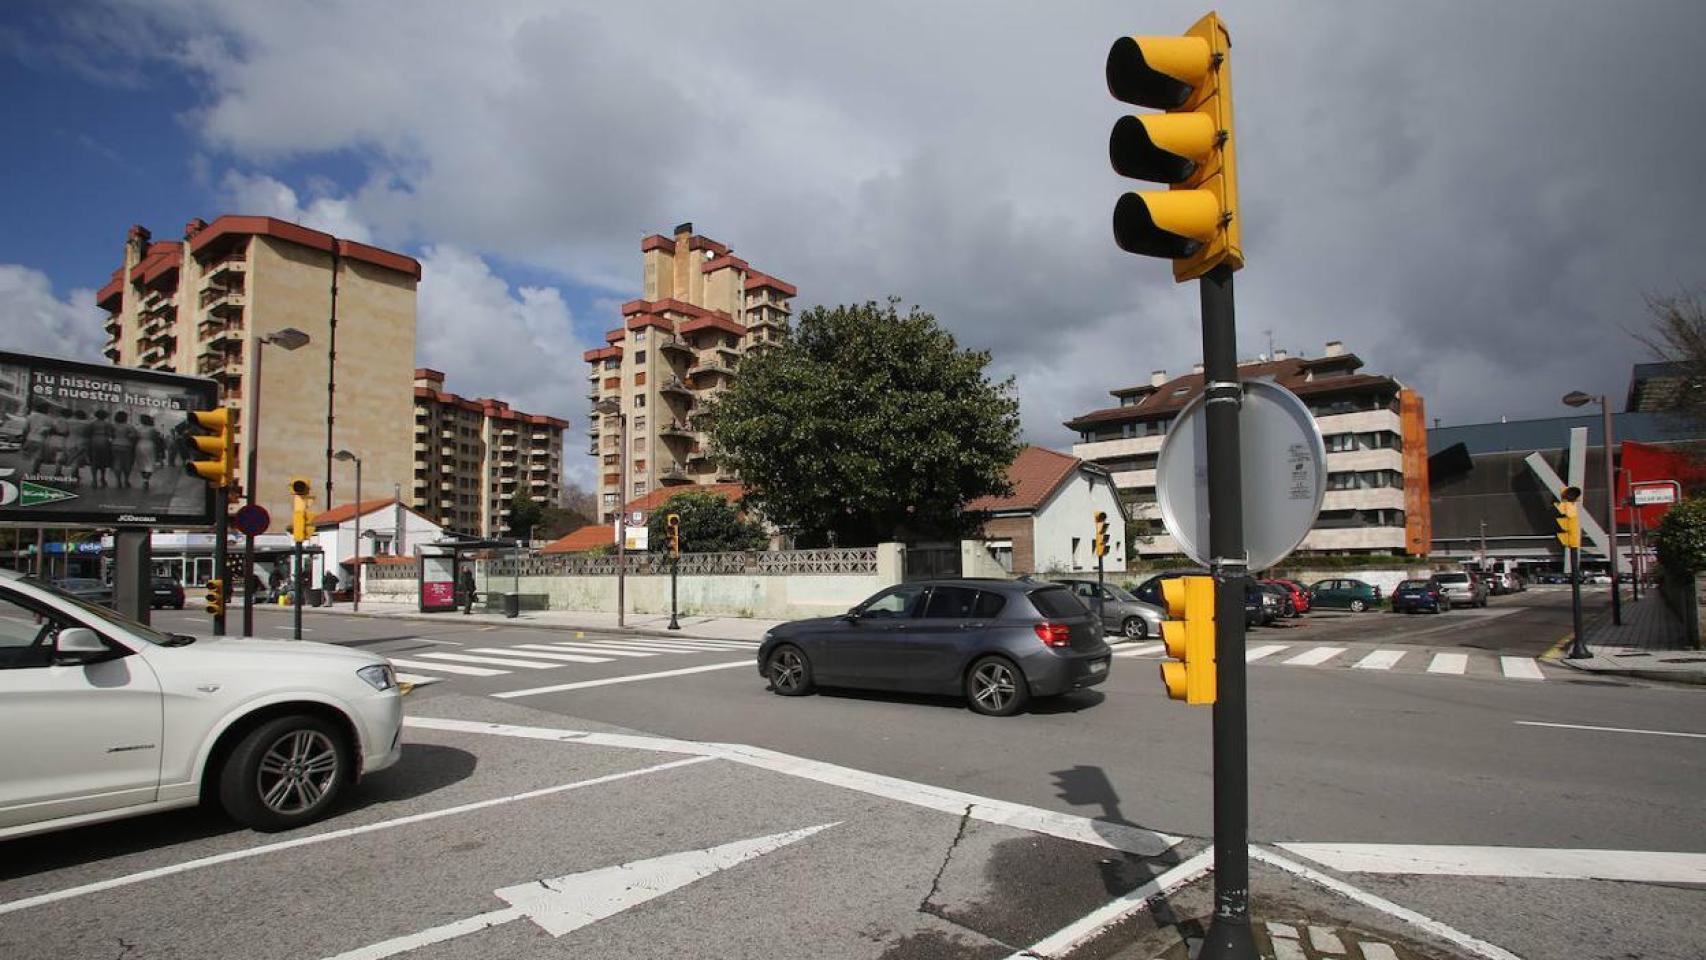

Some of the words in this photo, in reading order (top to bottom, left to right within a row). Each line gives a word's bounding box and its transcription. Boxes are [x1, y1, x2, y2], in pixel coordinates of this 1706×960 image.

[34, 371, 55, 384] Tu
[60, 375, 122, 393] historia
[33, 384, 53, 396] es
[58, 386, 120, 403] nuestra
[125, 392, 180, 410] historia
